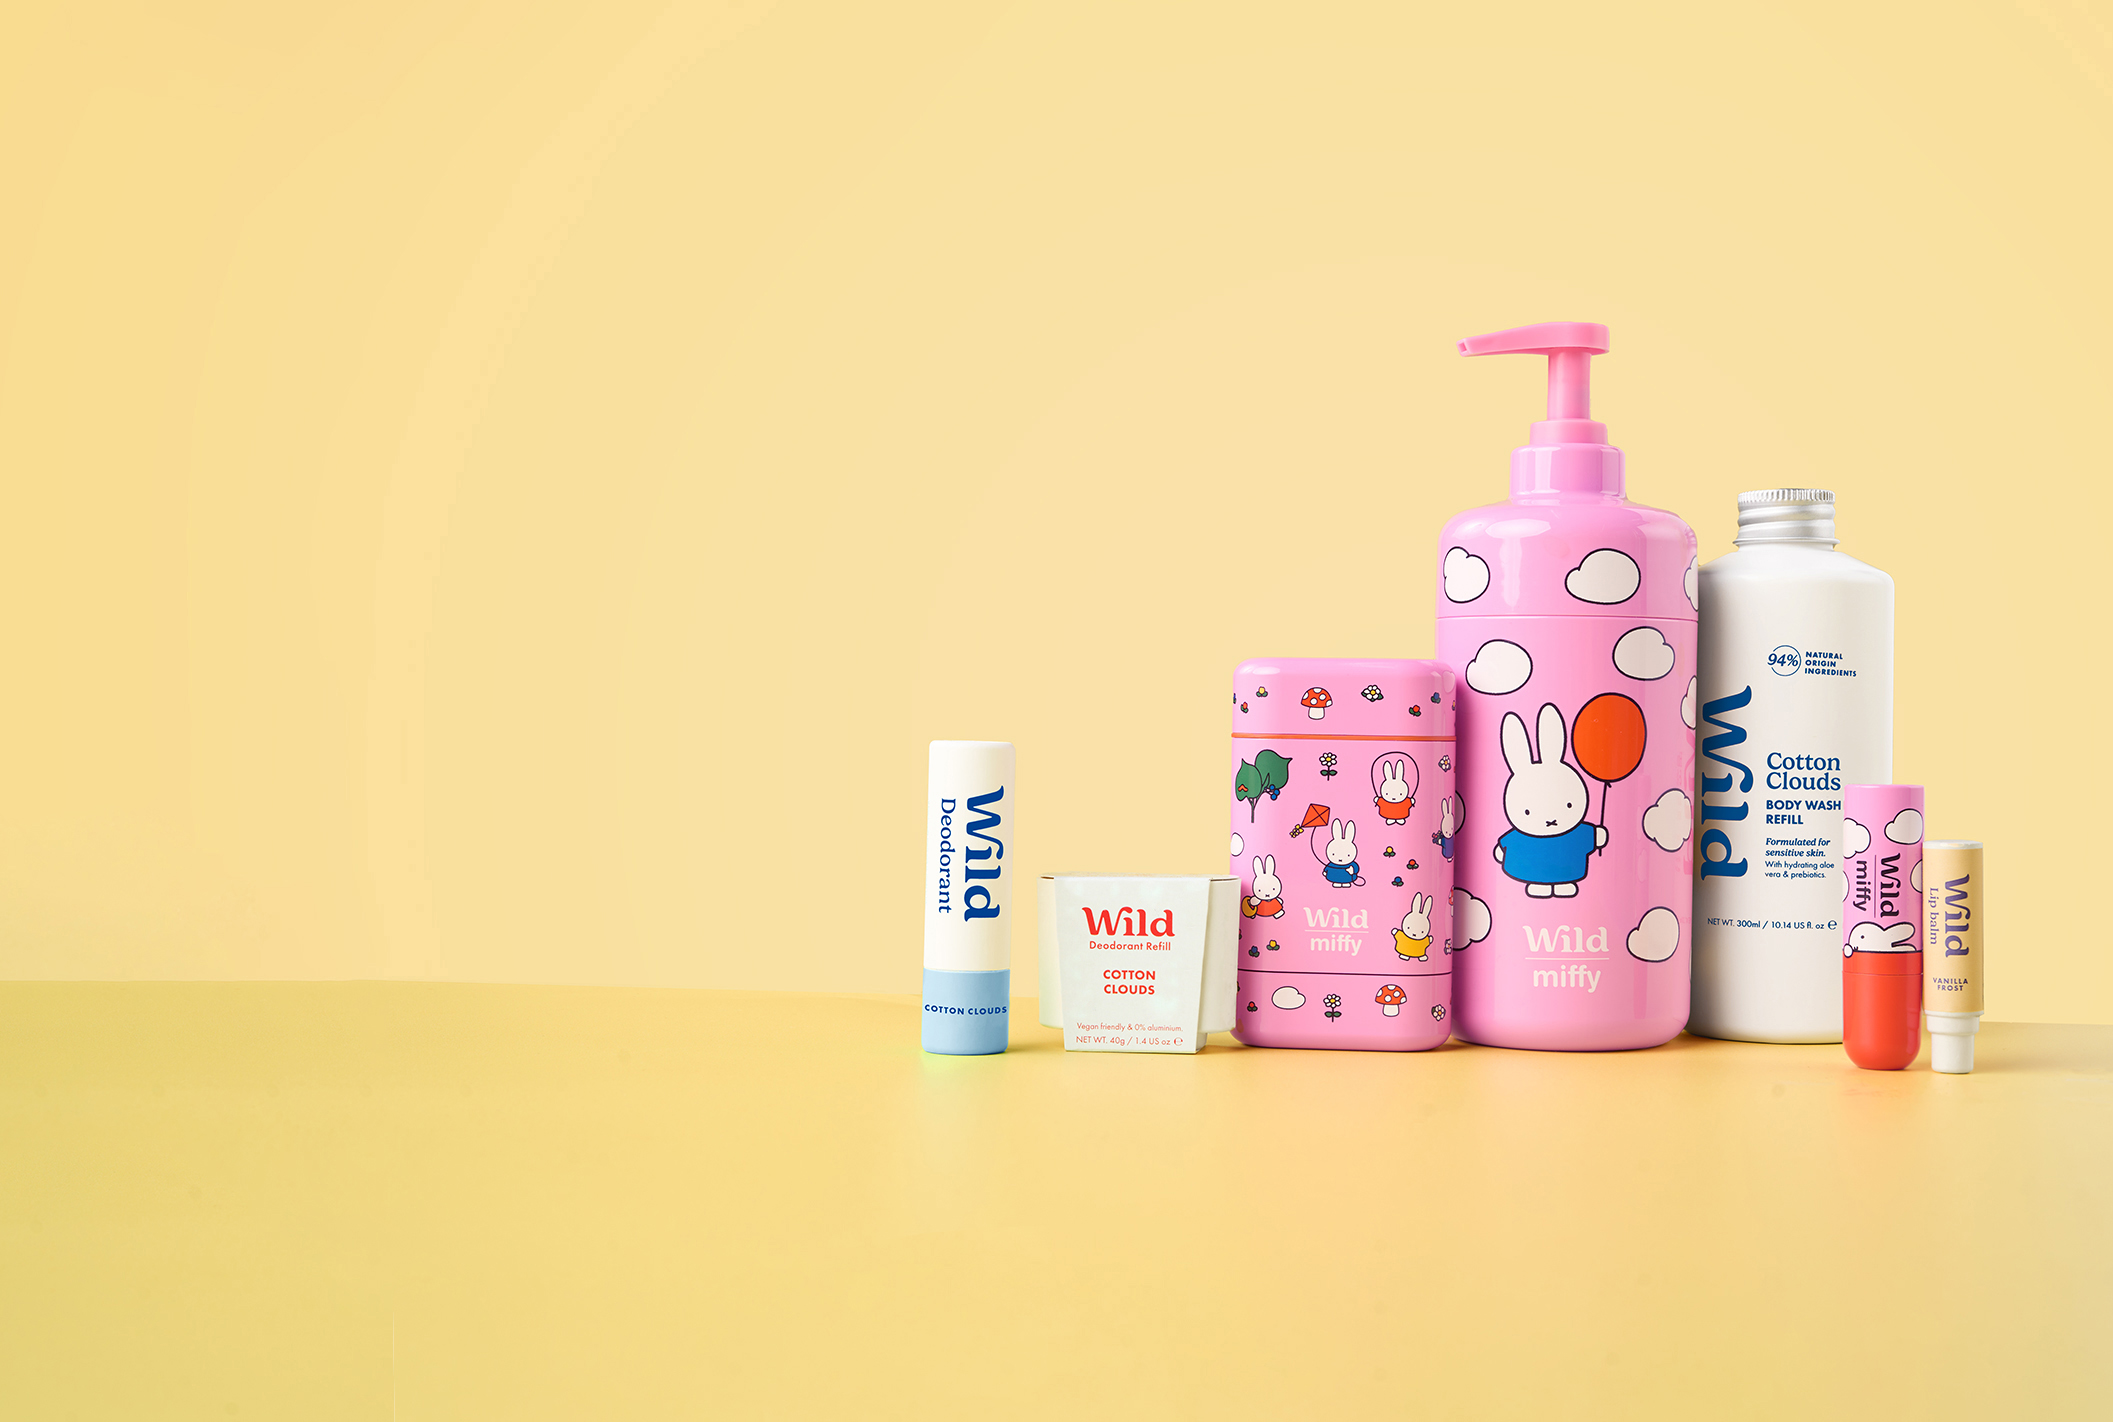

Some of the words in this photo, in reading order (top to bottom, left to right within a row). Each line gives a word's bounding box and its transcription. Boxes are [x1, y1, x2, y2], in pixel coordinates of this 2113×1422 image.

[1767, 653, 1799, 667] 94%
[1805, 651, 1843, 660] NATURAL
[1805, 659, 1836, 667] ORIGIN
[1804, 668, 1857, 677] INGREDIENTS
[1766, 752, 1841, 771] Cotton
[1700, 685, 1754, 881] Wild
[1766, 771, 1841, 790] Clouds
[1766, 800, 1802, 811] BODY
[1805, 800, 1841, 811] WASH
[1766, 815, 1804, 825] REFILL
[1766, 838, 1817, 846] Formulated
[1818, 838, 1831, 846] for
[939, 798, 956, 914] Deodorant
[964, 786, 1004, 922] Wild
[1765, 849, 1804, 857] sensitive
[1806, 849, 1826, 857] skin.
[1765, 860, 1782, 868] With
[1784, 861, 1818, 870] hydrating
[1783, 870, 1789, 878] &
[1791, 871, 1826, 879] prebiotics.
[1853, 860, 1871, 912] miffy
[1880, 853, 1901, 919] Wild
[1928, 887, 1939, 909] Lip
[1303, 907, 1369, 929] Wild
[1944, 873, 1971, 958] Wild
[1082, 906, 1175, 937] Wild
[1721, 919, 1735, 927] WT.
[1736, 920, 1761, 928] 300ml
[1762, 920, 1769, 929] /
[1771, 921, 1791, 929] 10.14
[1793, 921, 1805, 929] US
[1929, 911, 1940, 945] balm
[1523, 925, 1609, 953] Wild
[1089, 941, 1143, 951] Deodorant
[1146, 941, 1171, 951] Refill
[1310, 934, 1362, 957] miffy
[1103, 970, 1156, 981] COTTON
[1533, 964, 1601, 993] miffy
[1933, 977, 1969, 985] VANILLA
[1104, 984, 1155, 995] CLOUDS
[924, 1004, 965, 1015] COTTON
[968, 1006, 1008, 1015] CLOUDS
[1076, 1022, 1099, 1031] Vegan
[1100, 1022, 1125, 1032] friendly
[1127, 1023, 1133, 1031] &
[1134, 1023, 1146, 1031] 0%
[1147, 1024, 1183, 1032] aluminium.
[1093, 1036, 1108, 1044] WT.
[1110, 1036, 1125, 1046] 40g
[1126, 1036, 1133, 1045] /
[1149, 1037, 1160, 1045] US
